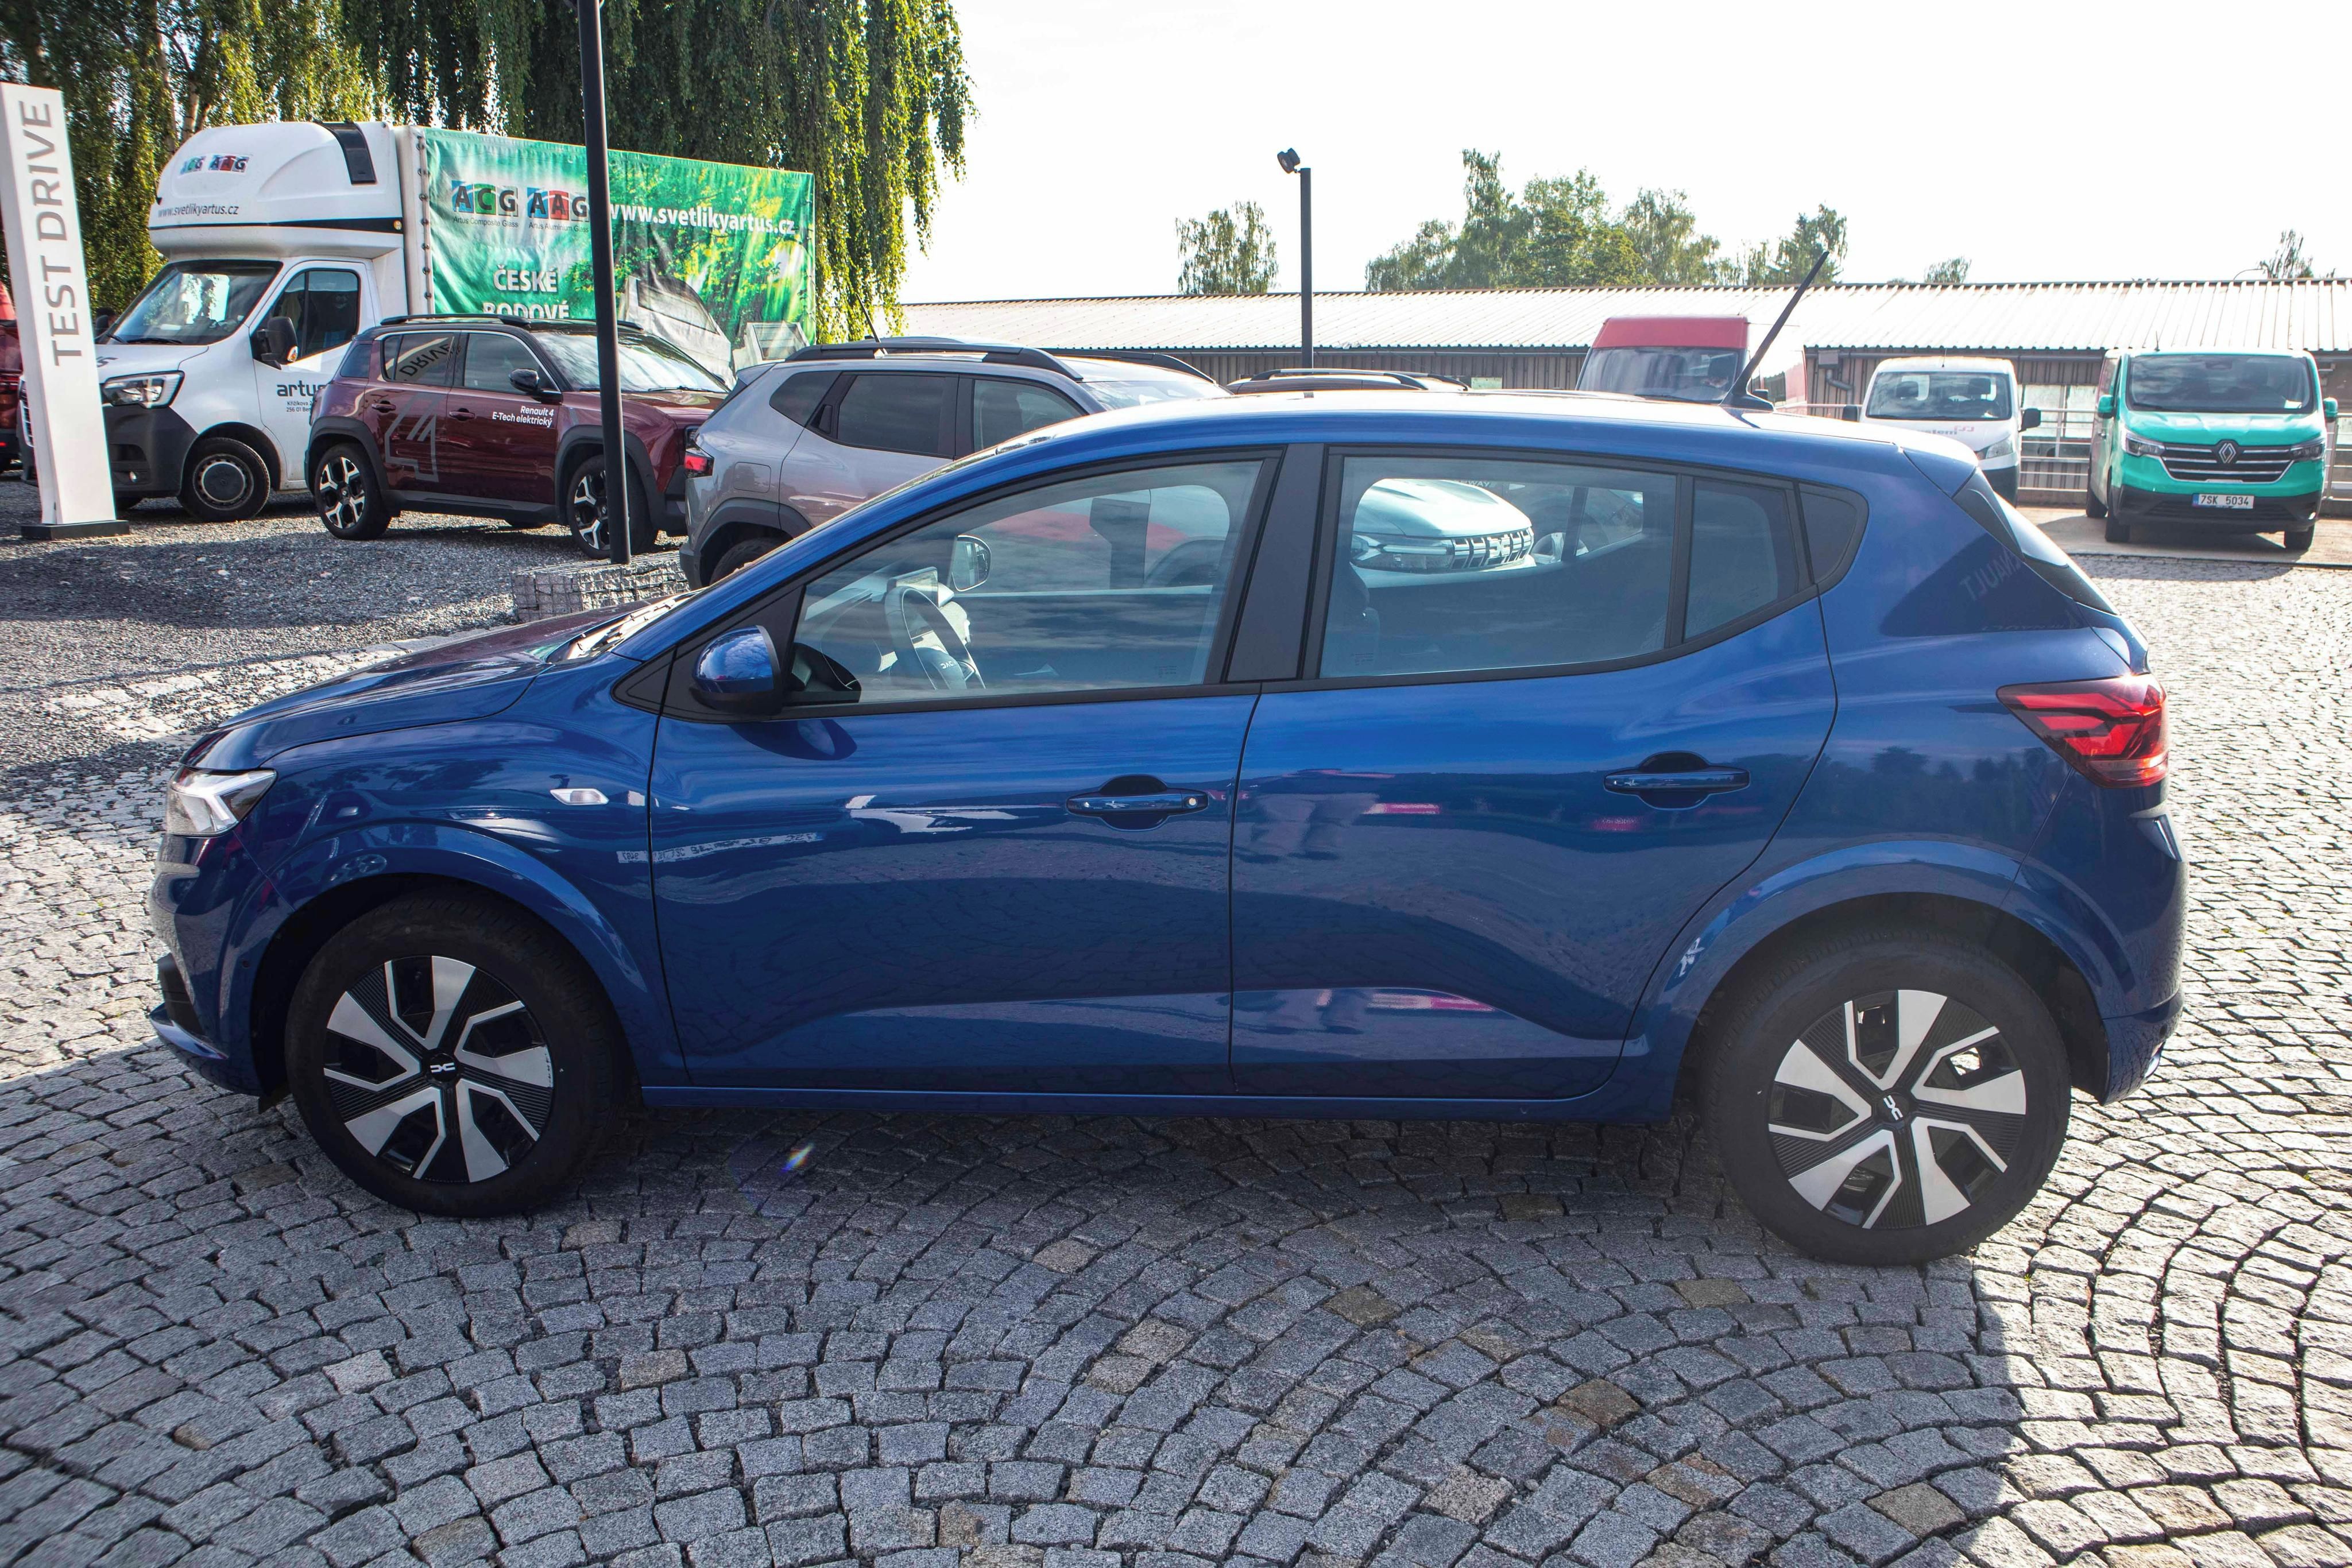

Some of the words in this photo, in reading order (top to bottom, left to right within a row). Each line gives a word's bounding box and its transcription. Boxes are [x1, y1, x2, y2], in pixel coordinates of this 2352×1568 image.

[19, 100, 67, 242] DRIVE
[454, 185, 517, 213] ACG
[529, 192, 589, 218] AAG
[157, 203, 239, 218] www.svetlikyartus.cz
[454, 216, 469, 224] Artus
[470, 218, 501, 226] Composite
[528, 222, 543, 230] Artus
[493, 264, 558, 292] ČESKÉ
[40, 255, 82, 366] TEST
[520, 405, 549, 416] Renault
[548, 409, 554, 417] 4
[492, 411, 515, 423] E-Tech
[516, 414, 552, 428] elektrický
[2200, 495, 2219, 505] 7SK
[2225, 495, 2249, 506] 5034
